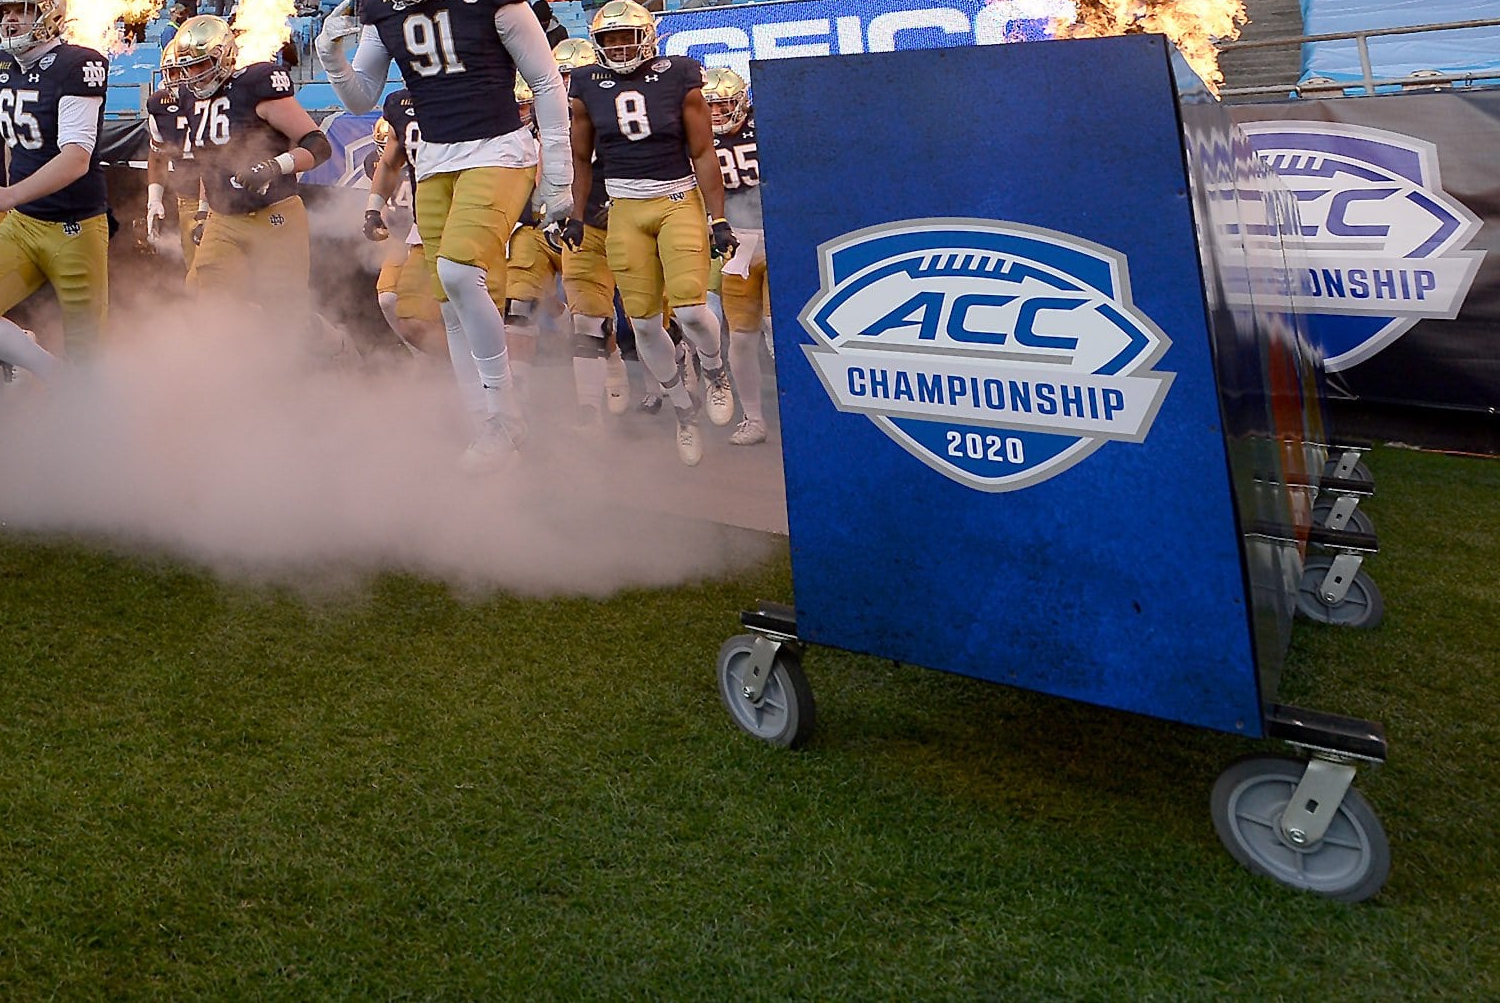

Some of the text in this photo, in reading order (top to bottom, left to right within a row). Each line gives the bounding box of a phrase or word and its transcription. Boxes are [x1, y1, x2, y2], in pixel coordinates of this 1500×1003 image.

[402, 8, 467, 78] 91
[194, 95, 231, 147] 76
[614, 89, 653, 142] 8
[857, 290, 1093, 351] ACC
[846, 365, 1126, 422] CHAMPIONSHIP
[946, 430, 1025, 465] 2020
